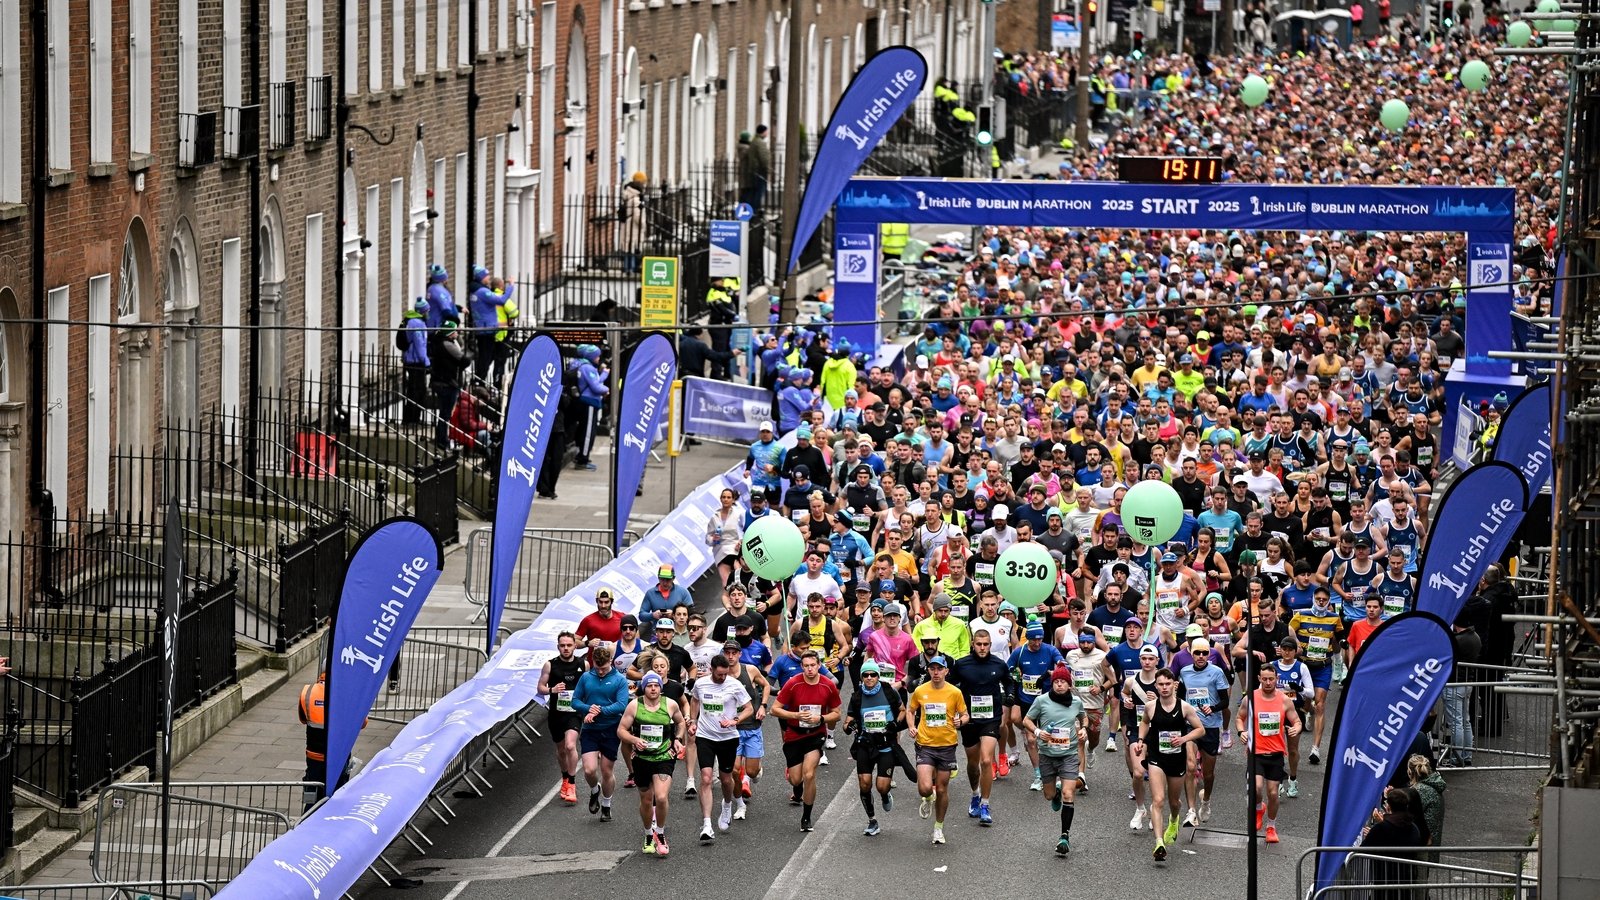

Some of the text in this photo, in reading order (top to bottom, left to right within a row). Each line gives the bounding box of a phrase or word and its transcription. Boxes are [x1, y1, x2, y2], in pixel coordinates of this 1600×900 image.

[856, 68, 917, 132] Irish Life
[1163, 160, 1215, 180] 19:11
[928, 197, 1092, 210] Irish Life DUBLIN MARATHON
[1102, 198, 1240, 214] 2025 START 2025
[1262, 201, 1428, 215] Irish Life DUBLIN MARATHON
[521, 362, 556, 460] Irish Life
[636, 361, 670, 434] Irish Life
[707, 402, 738, 414] Irish Life
[1453, 497, 1516, 577] Irish Life
[1006, 560, 1048, 580] 3:30
[362, 555, 430, 649] Irish Life
[1368, 656, 1444, 752] Irish Life
[349, 792, 392, 820] Irish Life
[298, 845, 342, 883] Irish Life
